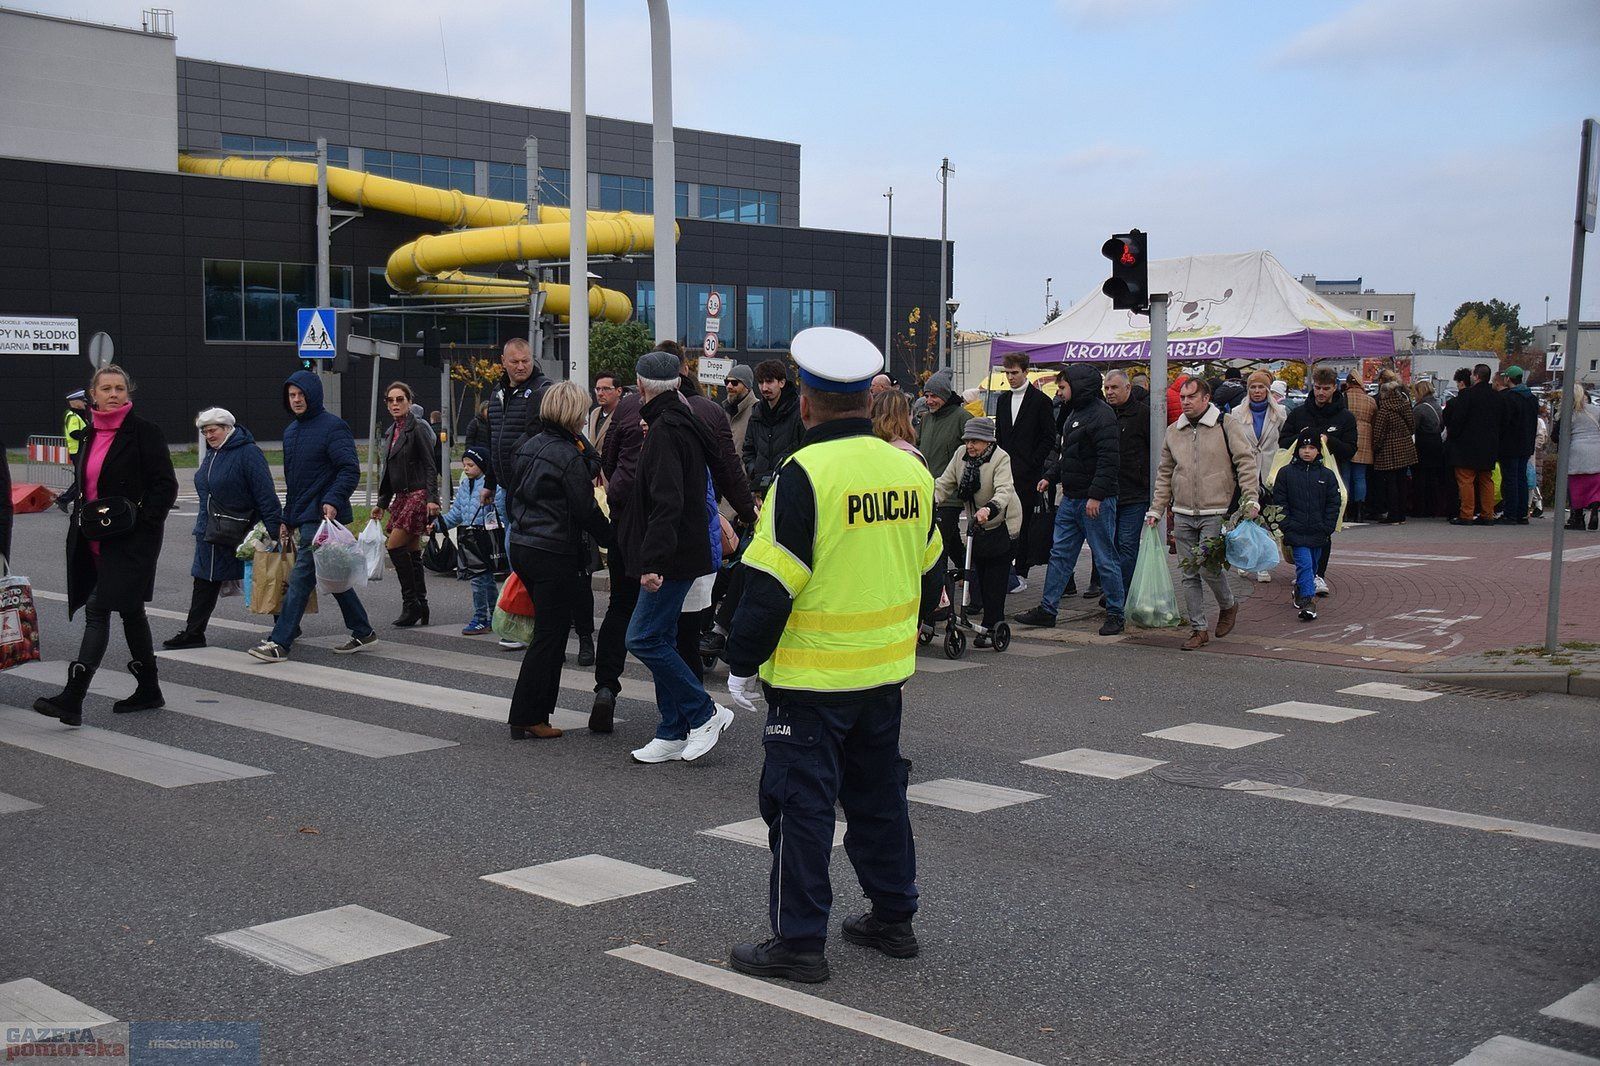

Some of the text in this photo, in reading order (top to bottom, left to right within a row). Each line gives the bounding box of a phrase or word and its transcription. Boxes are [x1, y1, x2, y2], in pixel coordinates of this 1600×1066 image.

[14, 329, 31, 338] NA
[33, 329, 77, 340] SŁODKO
[33, 342, 70, 351] DELFIN
[705, 339, 716, 351] 30
[1148, 340, 1221, 358] ARIBO
[571, 361, 577, 370] 2
[707, 361, 723, 371] Droga
[848, 490, 920, 525] POLICJA
[765, 724, 791, 737] POLICJA
